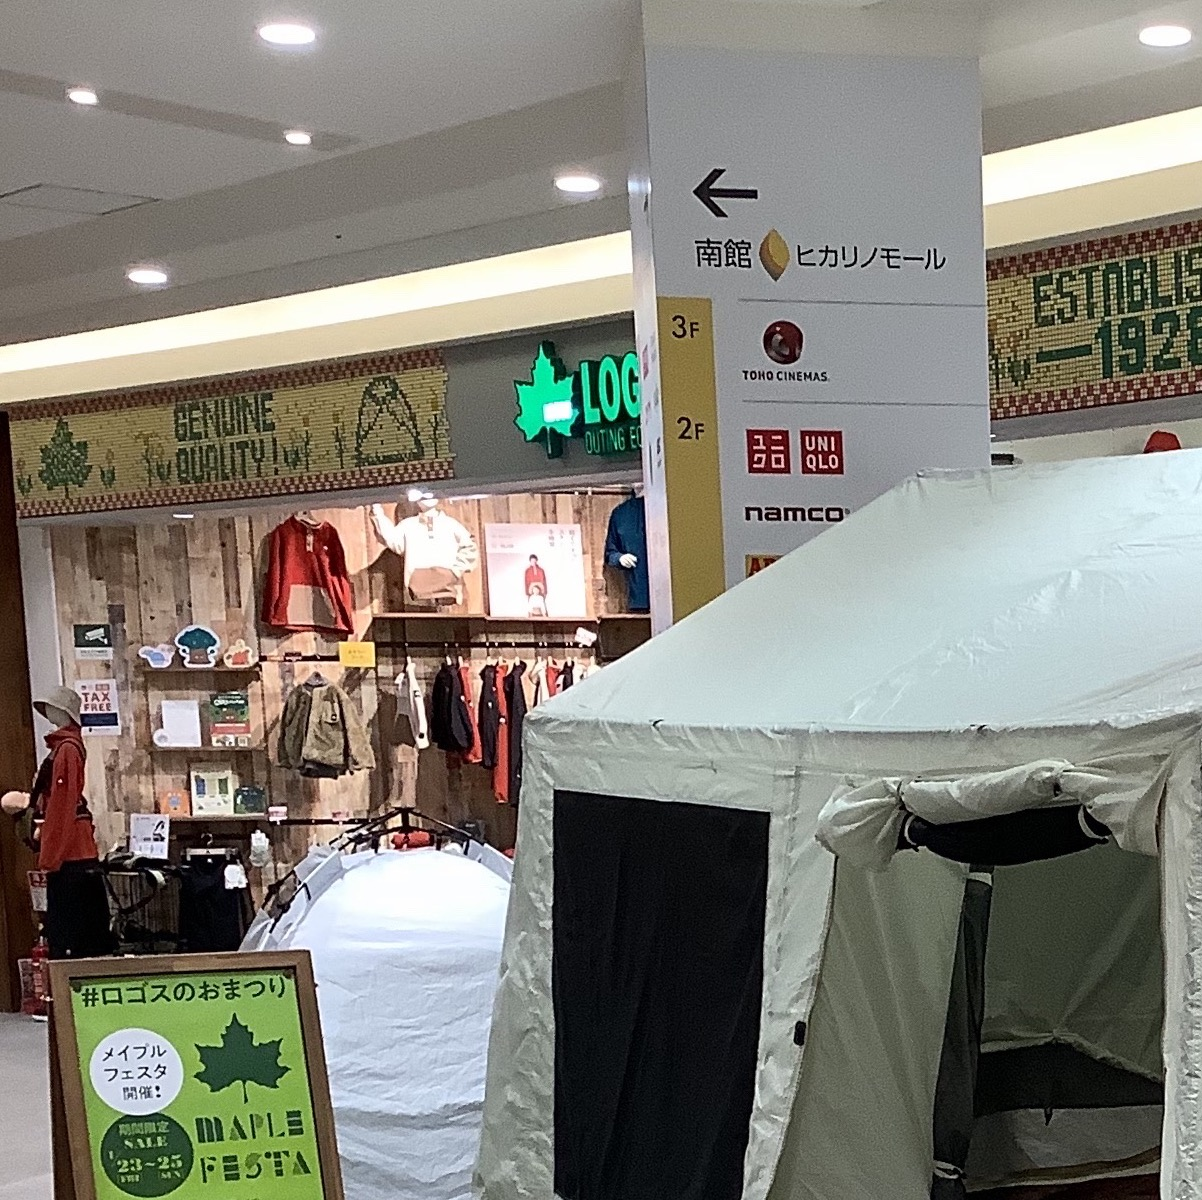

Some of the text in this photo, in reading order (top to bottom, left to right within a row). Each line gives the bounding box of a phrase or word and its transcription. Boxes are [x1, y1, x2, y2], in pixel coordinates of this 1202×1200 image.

[694, 238, 947, 271] 南館 ヒカリノモール
[671, 315, 700, 339] 3F
[742, 370, 829, 382] TOHO CINEMAS
[174, 392, 276, 442] GENUINE
[675, 416, 706, 440] 2F
[585, 427, 626, 454] OUTING
[176, 438, 279, 484] QUALITY!
[744, 506, 844, 522] namco
[82, 692, 111, 703] TAX
[83, 703, 112, 712] FREE
[81, 976, 286, 1008] #ロゴスのおまつり
[102, 1043, 167, 1062] メイプル
[103, 1063, 168, 1082] フェスタ
[194, 1110, 304, 1143] MAPLE
[200, 1150, 312, 1184] FESTA
